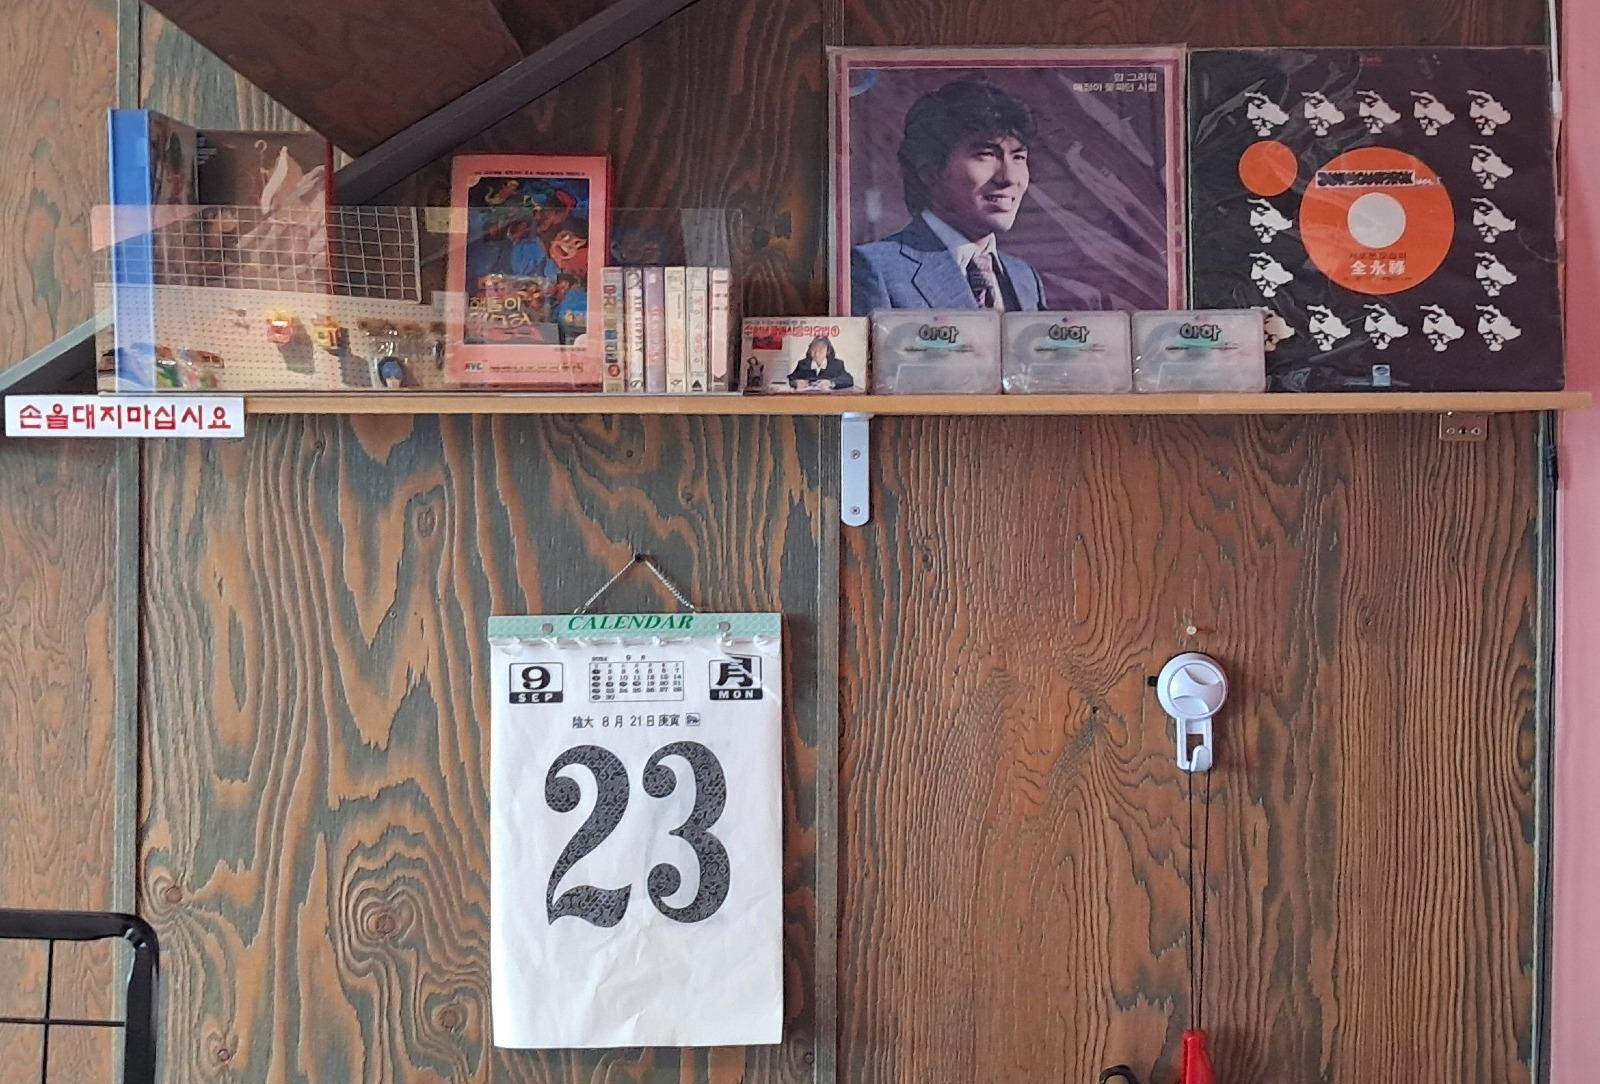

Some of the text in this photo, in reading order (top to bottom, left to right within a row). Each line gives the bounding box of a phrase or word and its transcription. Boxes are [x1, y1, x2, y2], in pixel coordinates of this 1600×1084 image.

[19, 403, 232, 430] 손을대지마십시요
[567, 614, 695, 630] CALENDAR
[521, 666, 551, 690] 9
[715, 656, 754, 688] 月
[518, 692, 554, 703] SEP
[718, 689, 755, 700] MON
[544, 741, 731, 928] 23
